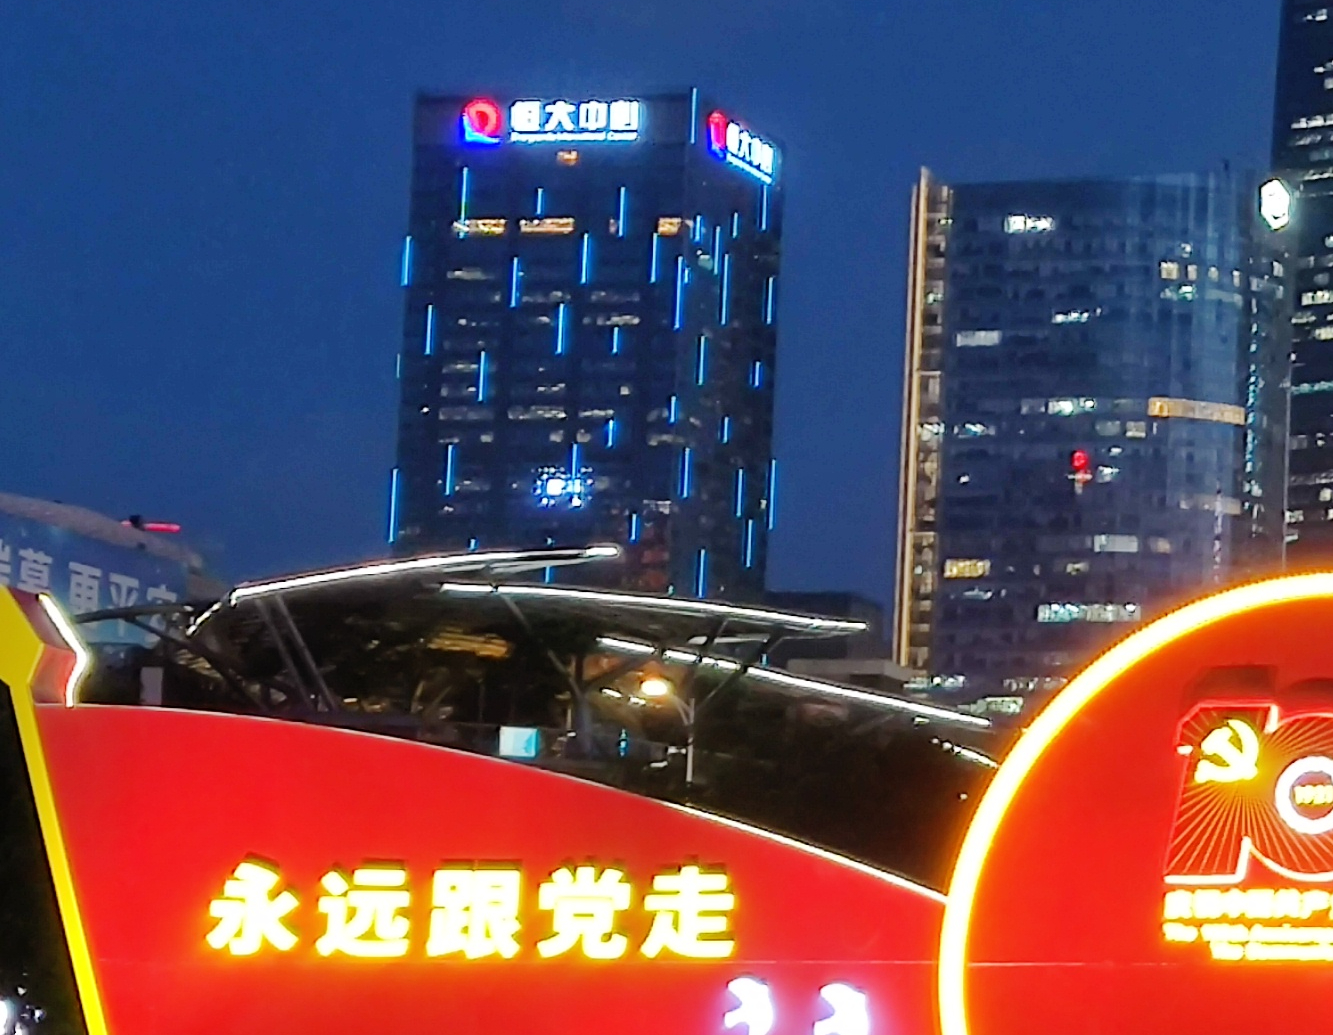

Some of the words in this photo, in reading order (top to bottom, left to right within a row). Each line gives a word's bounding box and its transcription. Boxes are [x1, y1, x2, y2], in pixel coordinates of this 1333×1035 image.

[205, 859, 737, 961] 永远跟党走
